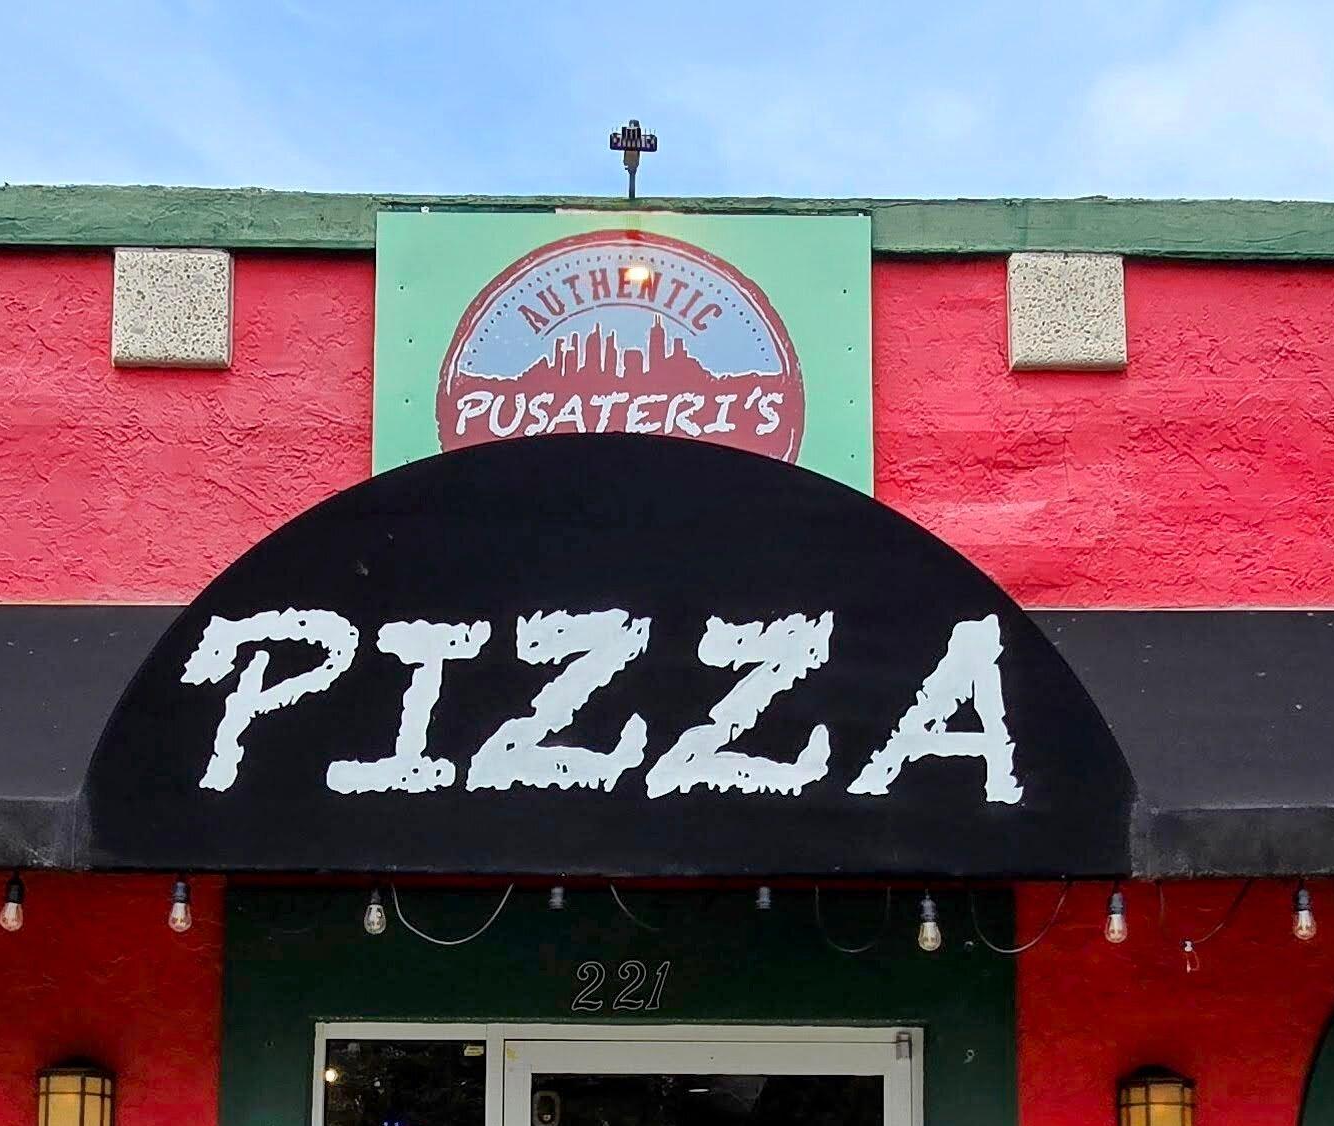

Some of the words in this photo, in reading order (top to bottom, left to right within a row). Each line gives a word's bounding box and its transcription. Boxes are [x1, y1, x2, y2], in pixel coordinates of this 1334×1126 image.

[517, 267, 723, 334] AUTHENTIC
[455, 387, 784, 437] PUSATERI'S
[180, 608, 1024, 804] PIZZA
[571, 960, 670, 1011] 221
